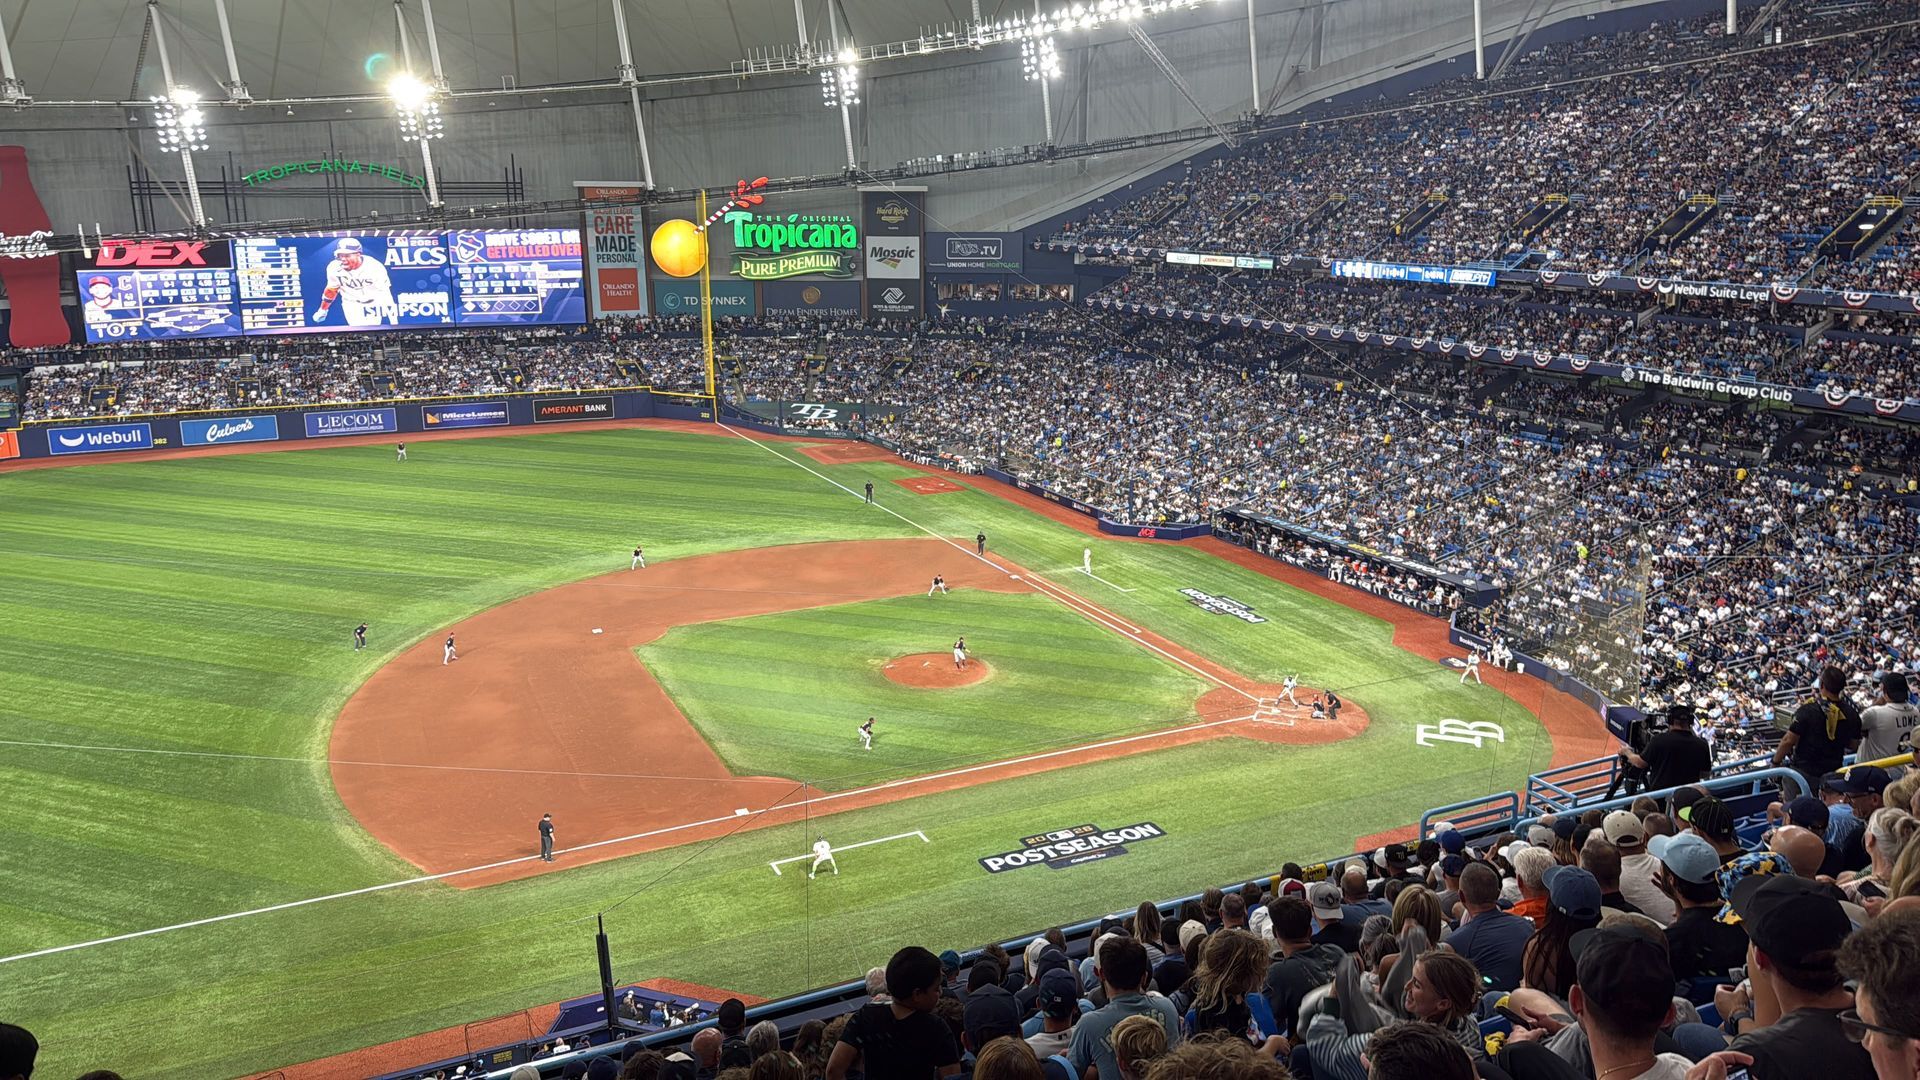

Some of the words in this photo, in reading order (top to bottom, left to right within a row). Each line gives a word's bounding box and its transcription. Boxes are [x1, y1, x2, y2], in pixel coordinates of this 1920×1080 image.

[241, 159, 363, 188] TROPICANA
[368, 162, 426, 189] FIELD
[594, 216, 635, 234] CARE
[724, 211, 857, 253] Tropicana
[487, 246, 508, 259] GET
[508, 244, 549, 258] PULLED
[551, 243, 582, 257] OVER
[596, 236, 637, 252] MADE
[870, 246, 915, 259] Mosaic
[96, 239, 206, 267] DEX
[384, 246, 447, 265] ALCS
[597, 253, 637, 263] PERSONAL
[741, 260, 777, 276] PURE
[779, 254, 840, 274] PREMIUM
[684, 296, 698, 305] TD
[1674, 283, 1708, 297] Webull
[1709, 286, 1738, 299] Suite
[1740, 288, 1770, 302] Level
[363, 303, 449, 317] SIMPSON
[766, 307, 795, 317] DREAM
[830, 307, 857, 317] HOMES
[1638, 370, 1660, 384] The
[1662, 375, 1714, 391] Baldwin
[1716, 382, 1758, 398] Group
[1760, 387, 1793, 402] Club
[541, 404, 583, 415] AMERANT
[584, 403, 607, 413] BANK
[317, 413, 384, 428] LECOM
[87, 429, 142, 446] Webull
[206, 418, 254, 443] Culver's
[983, 823, 1162, 872] POSTSEASON
